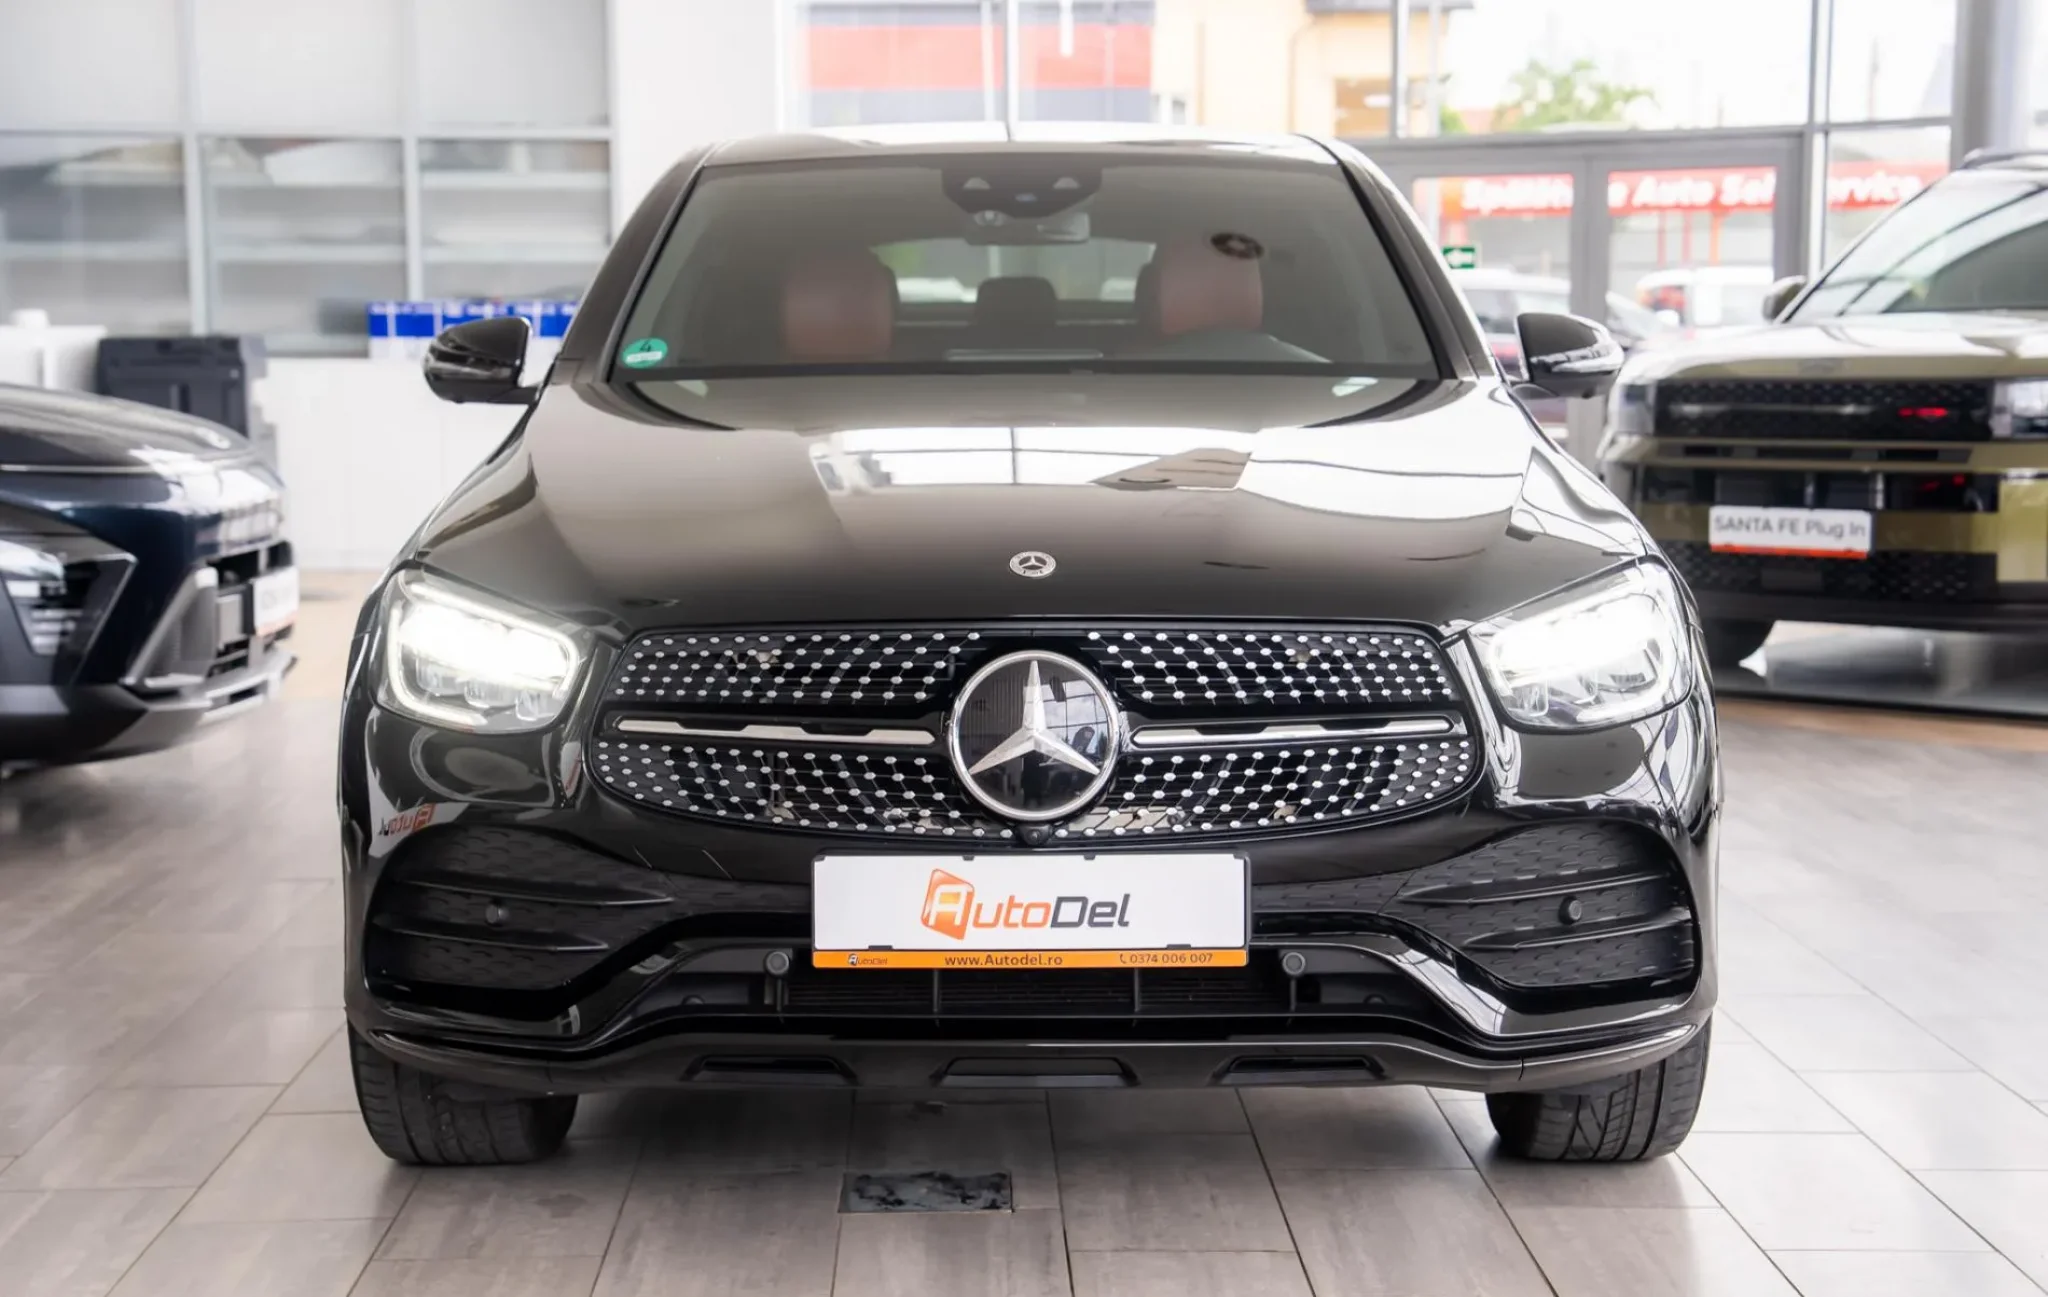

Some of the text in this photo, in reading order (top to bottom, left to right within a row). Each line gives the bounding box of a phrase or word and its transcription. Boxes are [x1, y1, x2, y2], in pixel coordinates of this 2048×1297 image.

[1714, 515, 1866, 541] SANTA FE Plug In
[926, 880, 1131, 931] AutoDel
[945, 954, 1063, 967] www.Autodel.ro
[1129, 952, 1214, 965] 0374 006 007
